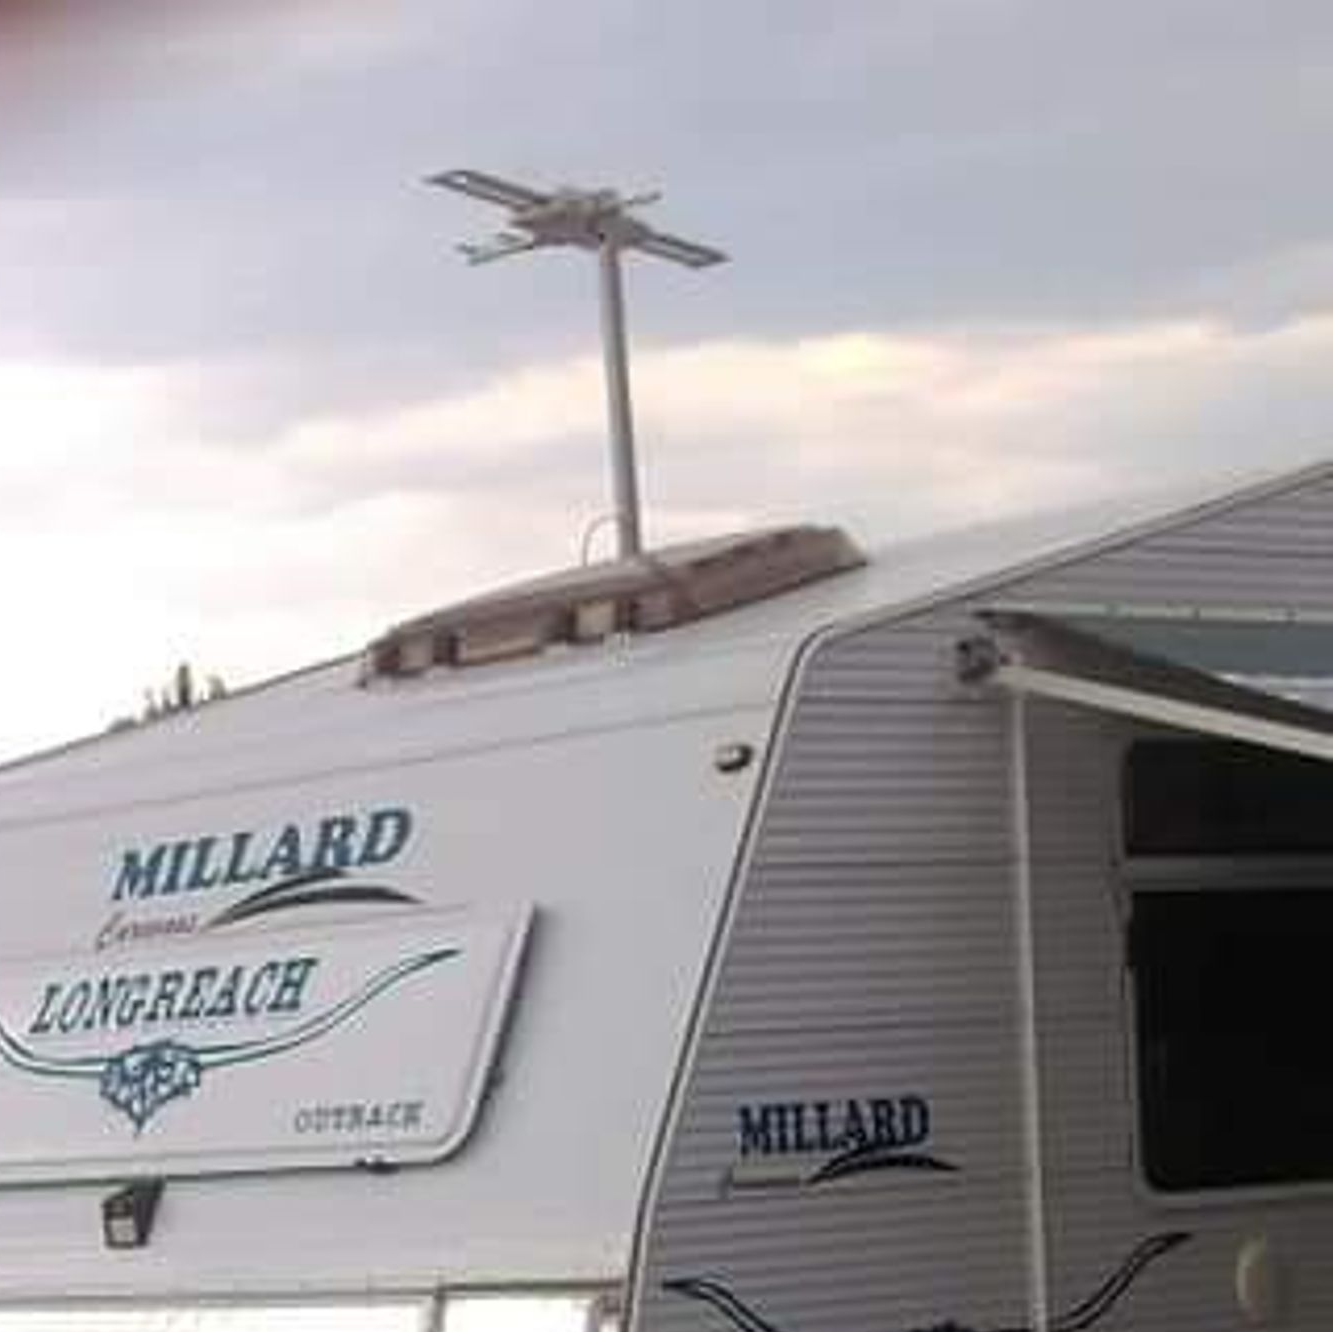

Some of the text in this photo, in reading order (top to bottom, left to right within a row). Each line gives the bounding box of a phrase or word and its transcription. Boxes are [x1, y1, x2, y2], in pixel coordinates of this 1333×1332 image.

[109, 807, 413, 902] MILLARD
[28, 956, 319, 1034] LONGREACH
[293, 1099, 425, 1134] OUTBACK
[738, 1096, 931, 1155] MILLARD
